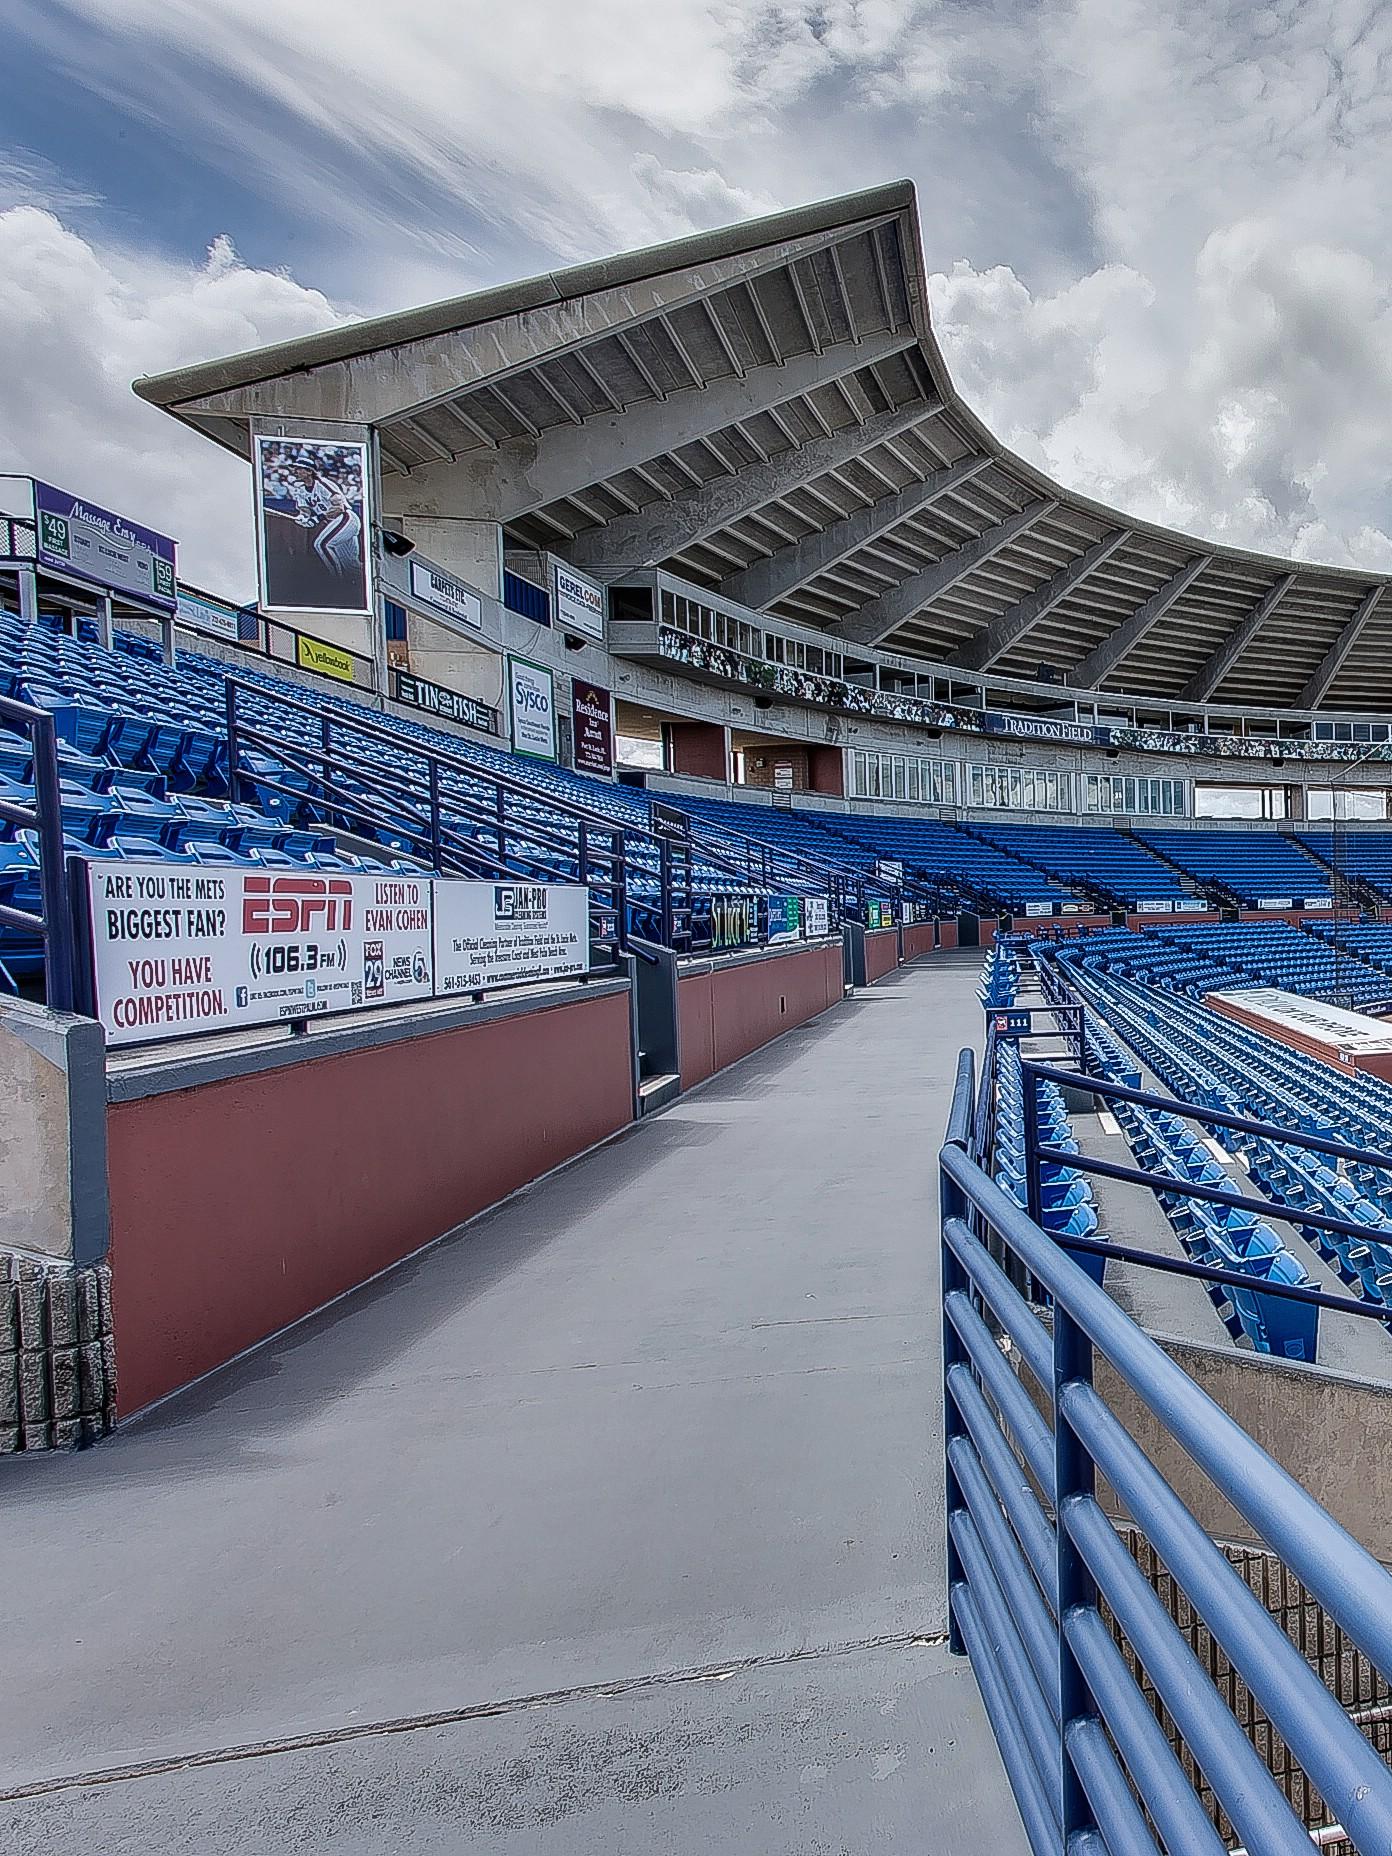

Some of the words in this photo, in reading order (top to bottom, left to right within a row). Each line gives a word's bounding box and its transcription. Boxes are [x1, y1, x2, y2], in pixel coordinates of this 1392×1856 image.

[69, 502, 111, 535] Massage
[48, 536, 63, 546] FIRST
[315, 651, 350, 672] yellowbook
[416, 681, 438, 709] TIN
[453, 695, 477, 723] FISH
[516, 681, 548, 712] Sysco
[576, 699, 608, 722] Residence
[1002, 716, 1060, 737] TRADITION
[1062, 722, 1093, 742] FIELD
[105, 876, 132, 899] ARE
[136, 876, 166, 899] YOU
[169, 877, 191, 899] THE
[195, 879, 225, 900] METS
[375, 883, 405, 904] LISTEN
[406, 884, 418, 904] TO
[515, 887, 547, 909] JAN-PRO
[243, 876, 353, 934] ESPN
[107, 909, 182, 939] BIGGEST
[187, 909, 226, 937] FAN?
[365, 910, 393, 931] EVAN
[396, 909, 428, 930] COHEN
[365, 942, 382, 957] FOX
[453, 939, 461, 952] The
[463, 938, 478, 951] Official
[265, 944, 318, 974] 106.3
[320, 952, 335, 967] FM
[393, 957, 410, 967] NEWS
[128, 959, 165, 989] YOU
[171, 957, 211, 985] HAVE
[365, 960, 383, 987] 29
[385, 969, 412, 980] CHANNEL
[113, 990, 228, 1028] COMPETITION.
[1010, 1018, 1028, 1027] 111
